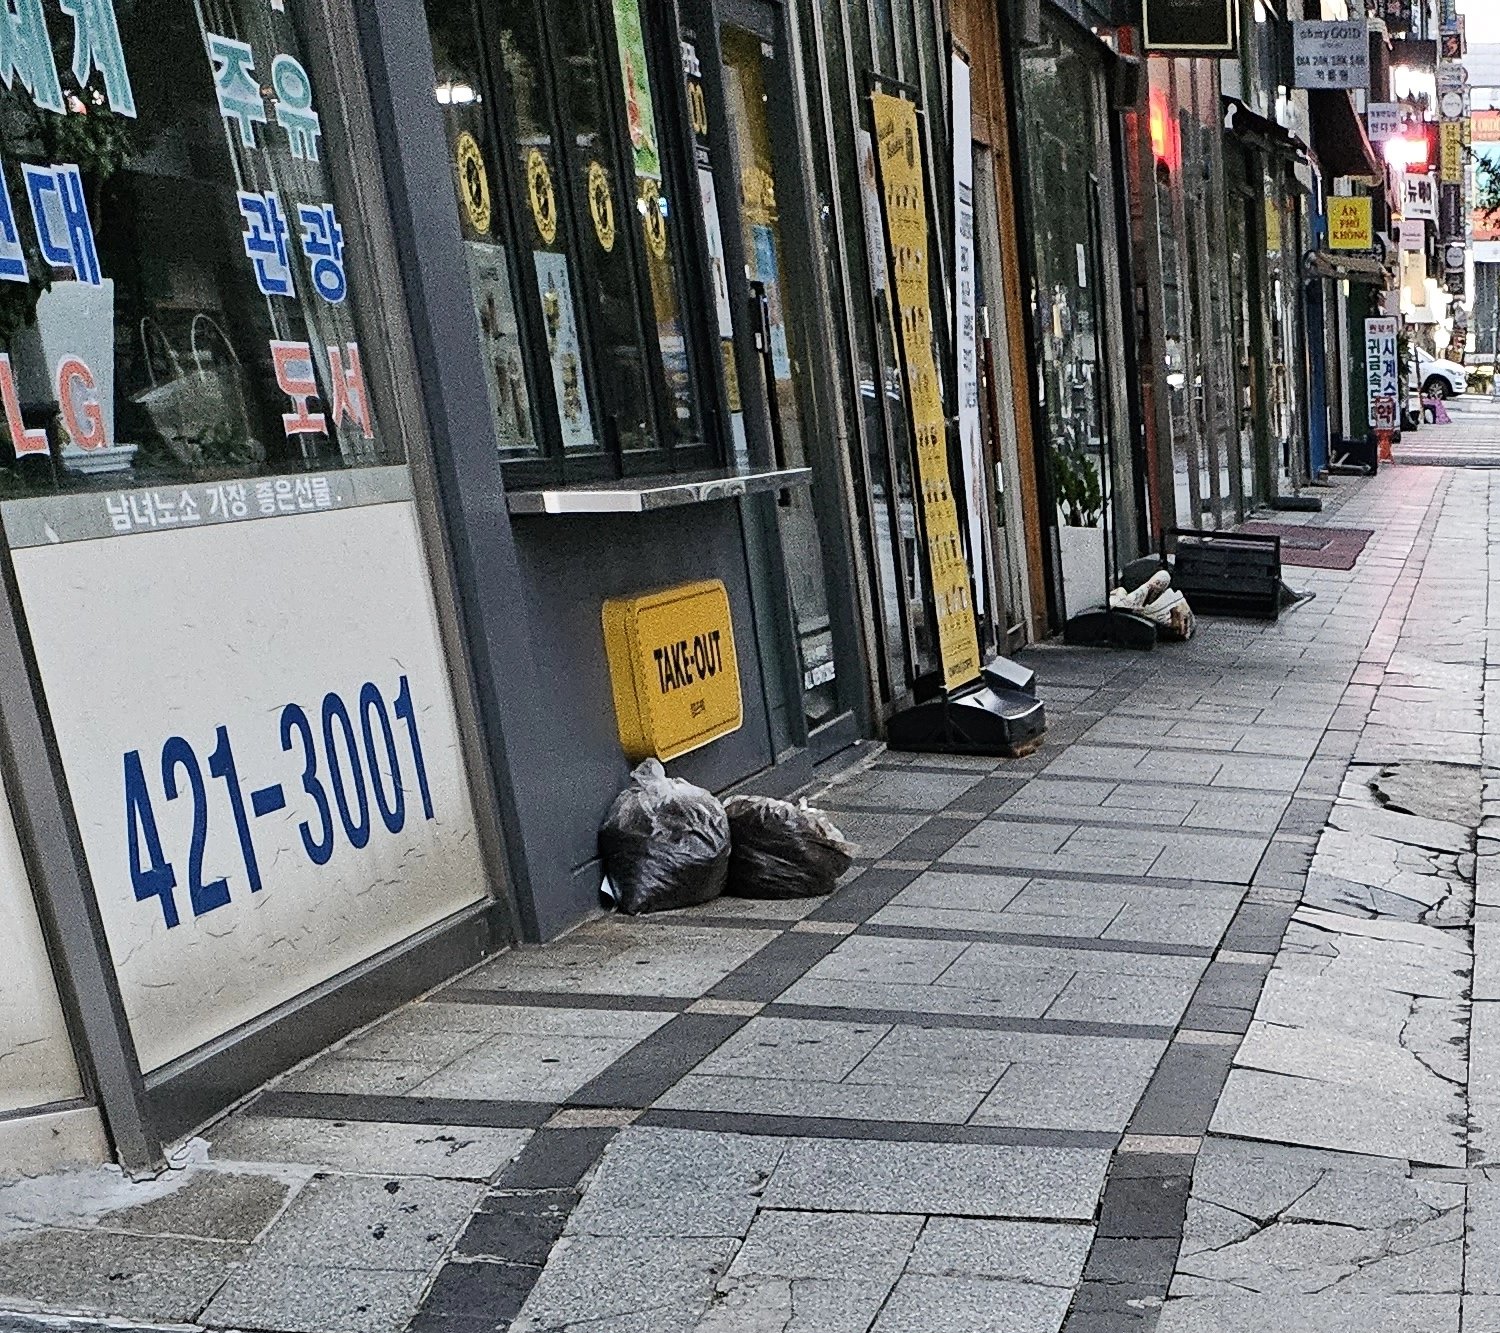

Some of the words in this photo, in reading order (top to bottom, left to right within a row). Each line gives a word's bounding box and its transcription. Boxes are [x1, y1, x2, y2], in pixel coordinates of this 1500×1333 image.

[207, 32, 321, 162] 주유
[237, 190, 347, 301] 관광
[0, 353, 108, 459] LG
[270, 340, 375, 440] 도서
[106, 490, 201, 531] 남녀노소
[205, 483, 248, 520] 가장
[653, 629, 723, 694] TAKE-OUT
[124, 675, 434, 930] 421-3001
